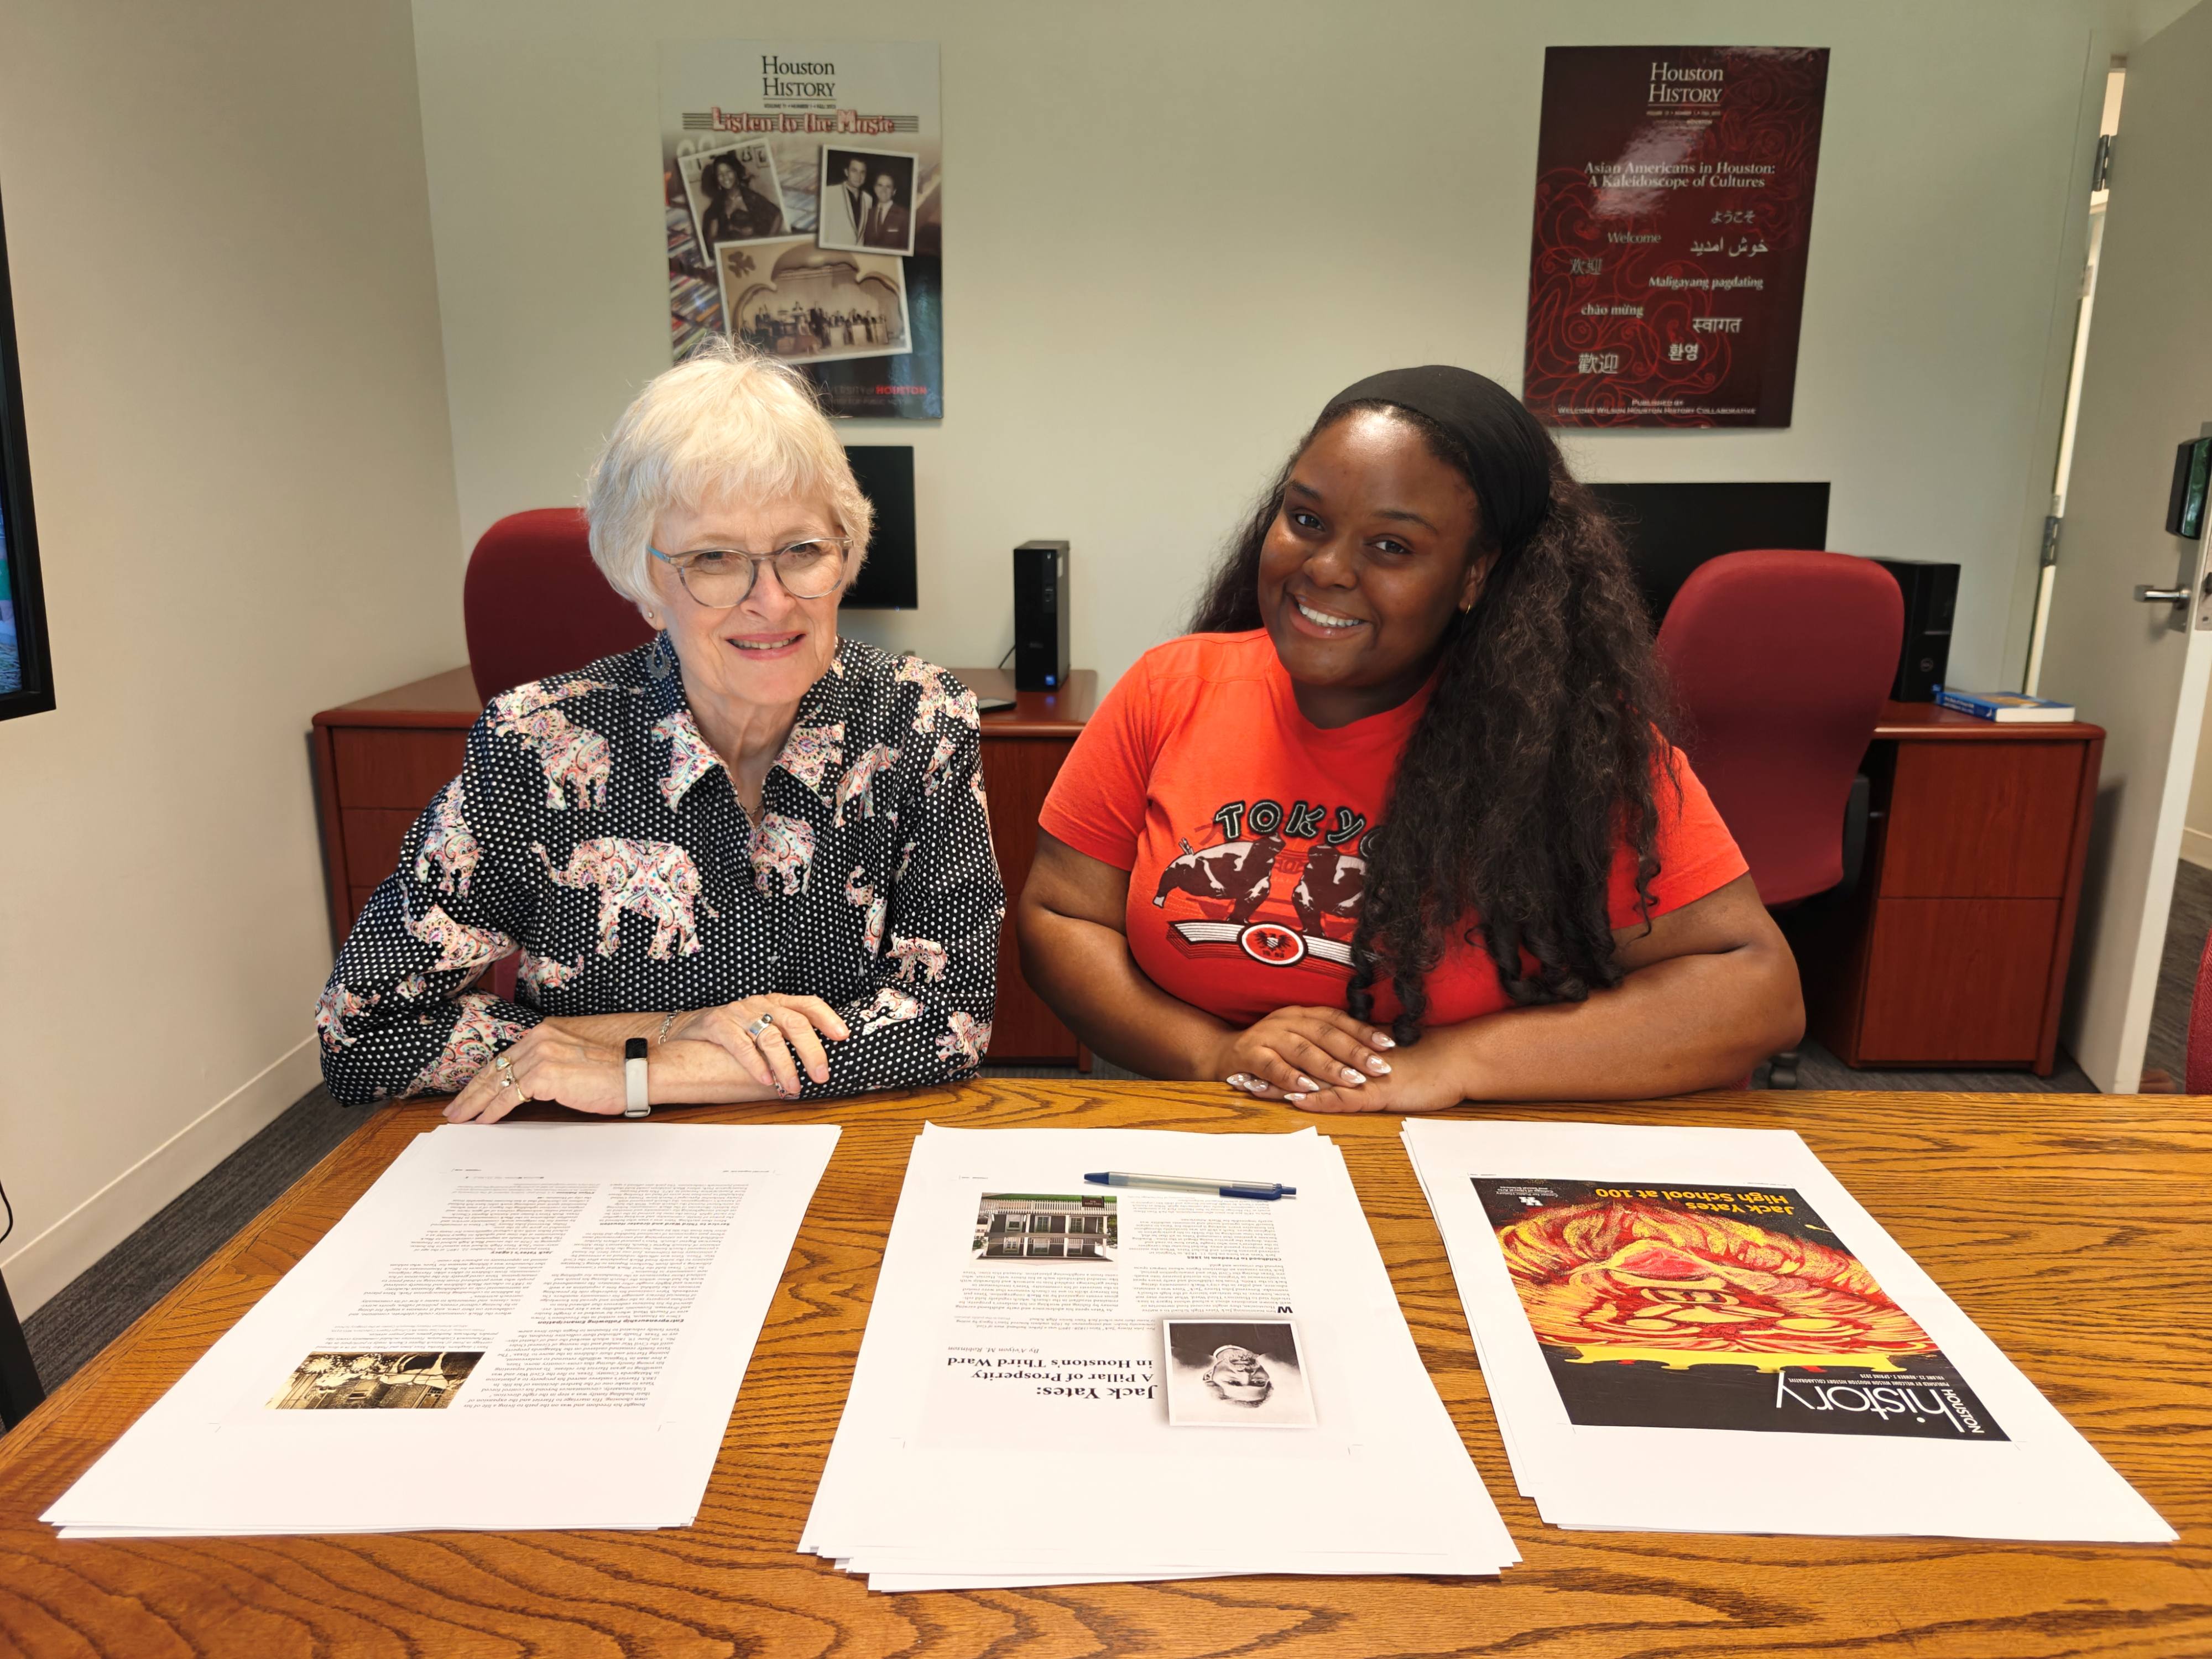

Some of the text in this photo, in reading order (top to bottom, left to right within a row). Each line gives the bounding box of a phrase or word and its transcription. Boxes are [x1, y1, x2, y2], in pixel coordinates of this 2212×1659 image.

[761, 55, 835, 75] Houston
[1650, 62, 1724, 81] Houston
[763, 77, 836, 97] HISTORY
[1648, 84, 1723, 103] HISTORY
[711, 106, 895, 135] Listen to the Music
[1584, 161, 1776, 174] Asian Americans in Houston:
[1588, 174, 1765, 190] A Kaleidoscope of Cultures
[1711, 210, 1755, 224] ようこそ
[1608, 231, 1661, 243] Welcome
[1570, 258, 1603, 275] 欢迎
[1648, 275, 1764, 291] Maligayang pagdating
[1581, 302, 1645, 319] chào mừng
[1692, 317, 1743, 333] स्वागत
[1668, 343, 1699, 361] 환영
[1578, 352, 1619, 374] 歡迎
[875, 385, 927, 395] HOUSTON
[1595, 1189, 1789, 1204] High School at 100
[1685, 1202, 1794, 1215] Jack Yates
[947, 1358, 1152, 1369] in Houston's Third Ward
[970, 1370, 1154, 1383] A Pillar of Prosperity
[1036, 1385, 1158, 1399] Jack Yates:
[1776, 1371, 1965, 1433] history
[1940, 1389, 1985, 1433] HOUSTON
